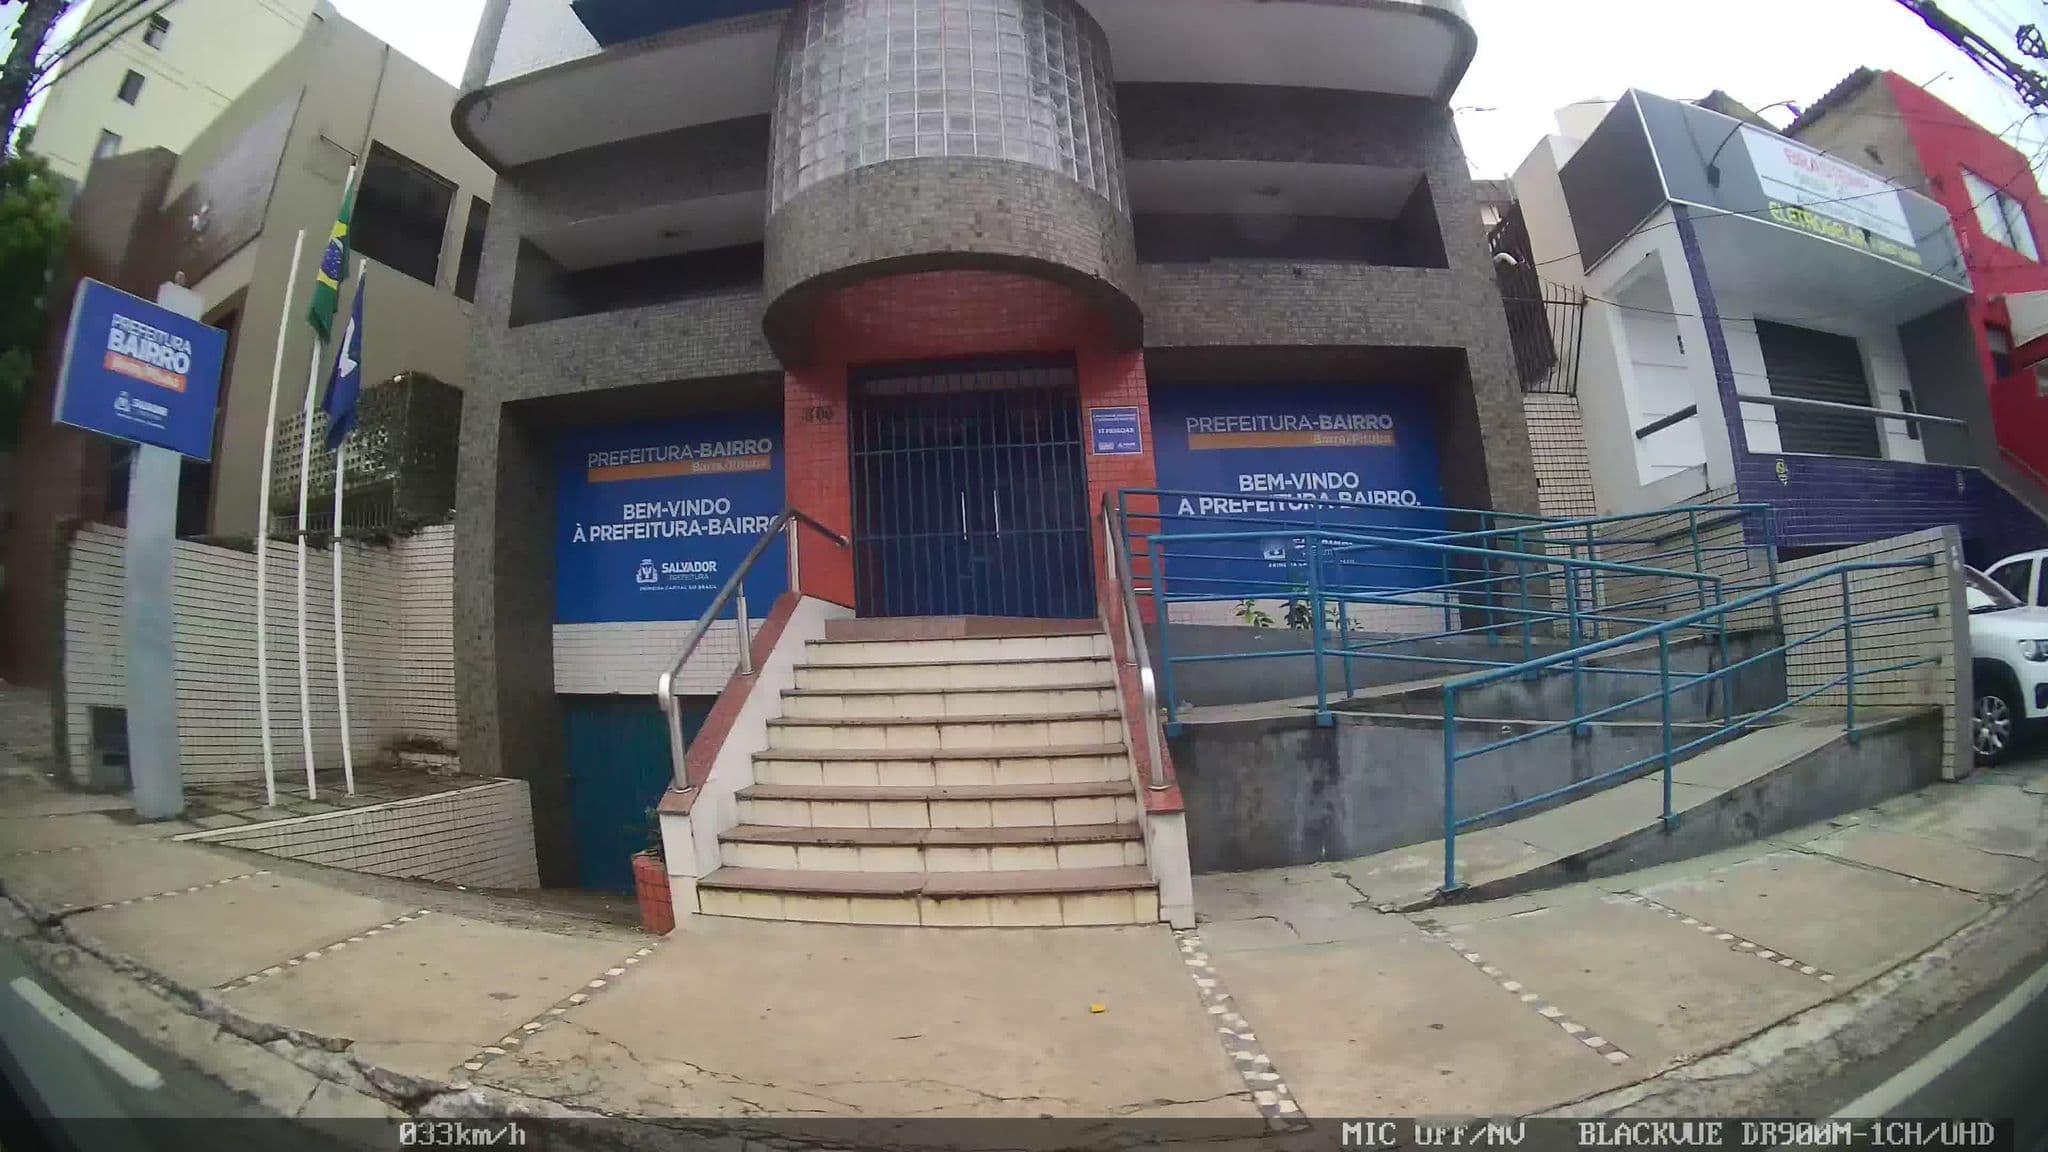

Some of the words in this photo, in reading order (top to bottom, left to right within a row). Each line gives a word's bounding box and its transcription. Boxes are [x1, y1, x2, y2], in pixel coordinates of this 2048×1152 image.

[111, 313, 192, 356] PREFEITURA
[107, 328, 190, 374] BAIRRO
[1186, 414, 1394, 433] PREFEITURA-BAIRRO
[588, 438, 773, 468] PREFEITURA-BAIRRO
[1239, 472, 1360, 492] BEM-VINDO
[623, 497, 731, 521] BEM-VINDO
[1200, 489, 1421, 515] PREFEITURABAIRRO.
[572, 523, 587, 543] À
[661, 560, 717, 574] SALVADOR
